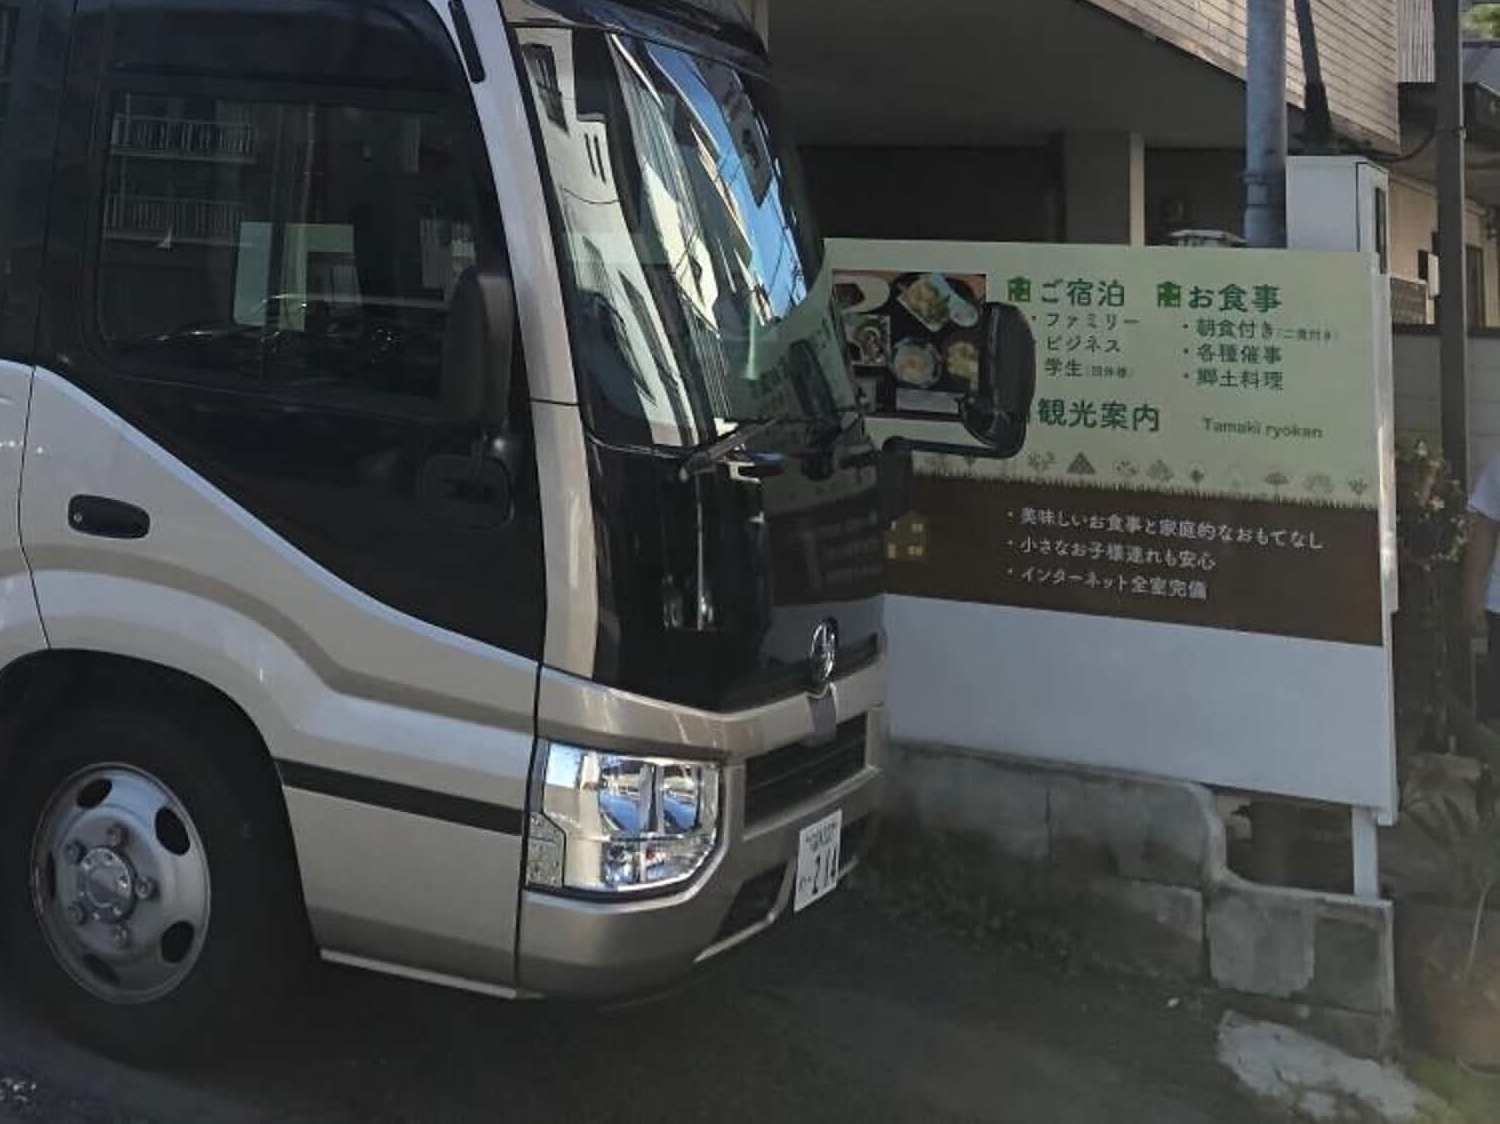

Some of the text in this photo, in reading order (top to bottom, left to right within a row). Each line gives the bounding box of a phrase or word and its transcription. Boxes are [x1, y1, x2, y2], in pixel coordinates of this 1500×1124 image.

[1040, 278, 1125, 308] ご宿泊
[1188, 283, 1283, 313] お食事
[1046, 313, 1141, 331] ファミリー
[1196, 318, 1274, 339] 朝食付き
[1047, 335, 1122, 353] ビジネス
[1196, 343, 1283, 365] 各種催事
[1044, 358, 1084, 377] 学生
[1196, 367, 1284, 390] 郷土料理
[1037, 398, 1160, 432] 観光案内
[1203, 417, 1324, 440] Tamaki ryokan
[1020, 507, 1324, 550] 美味しいお食事と家庭的なおもてなし
[1020, 534, 1217, 571] 小さなお子様連れも安心
